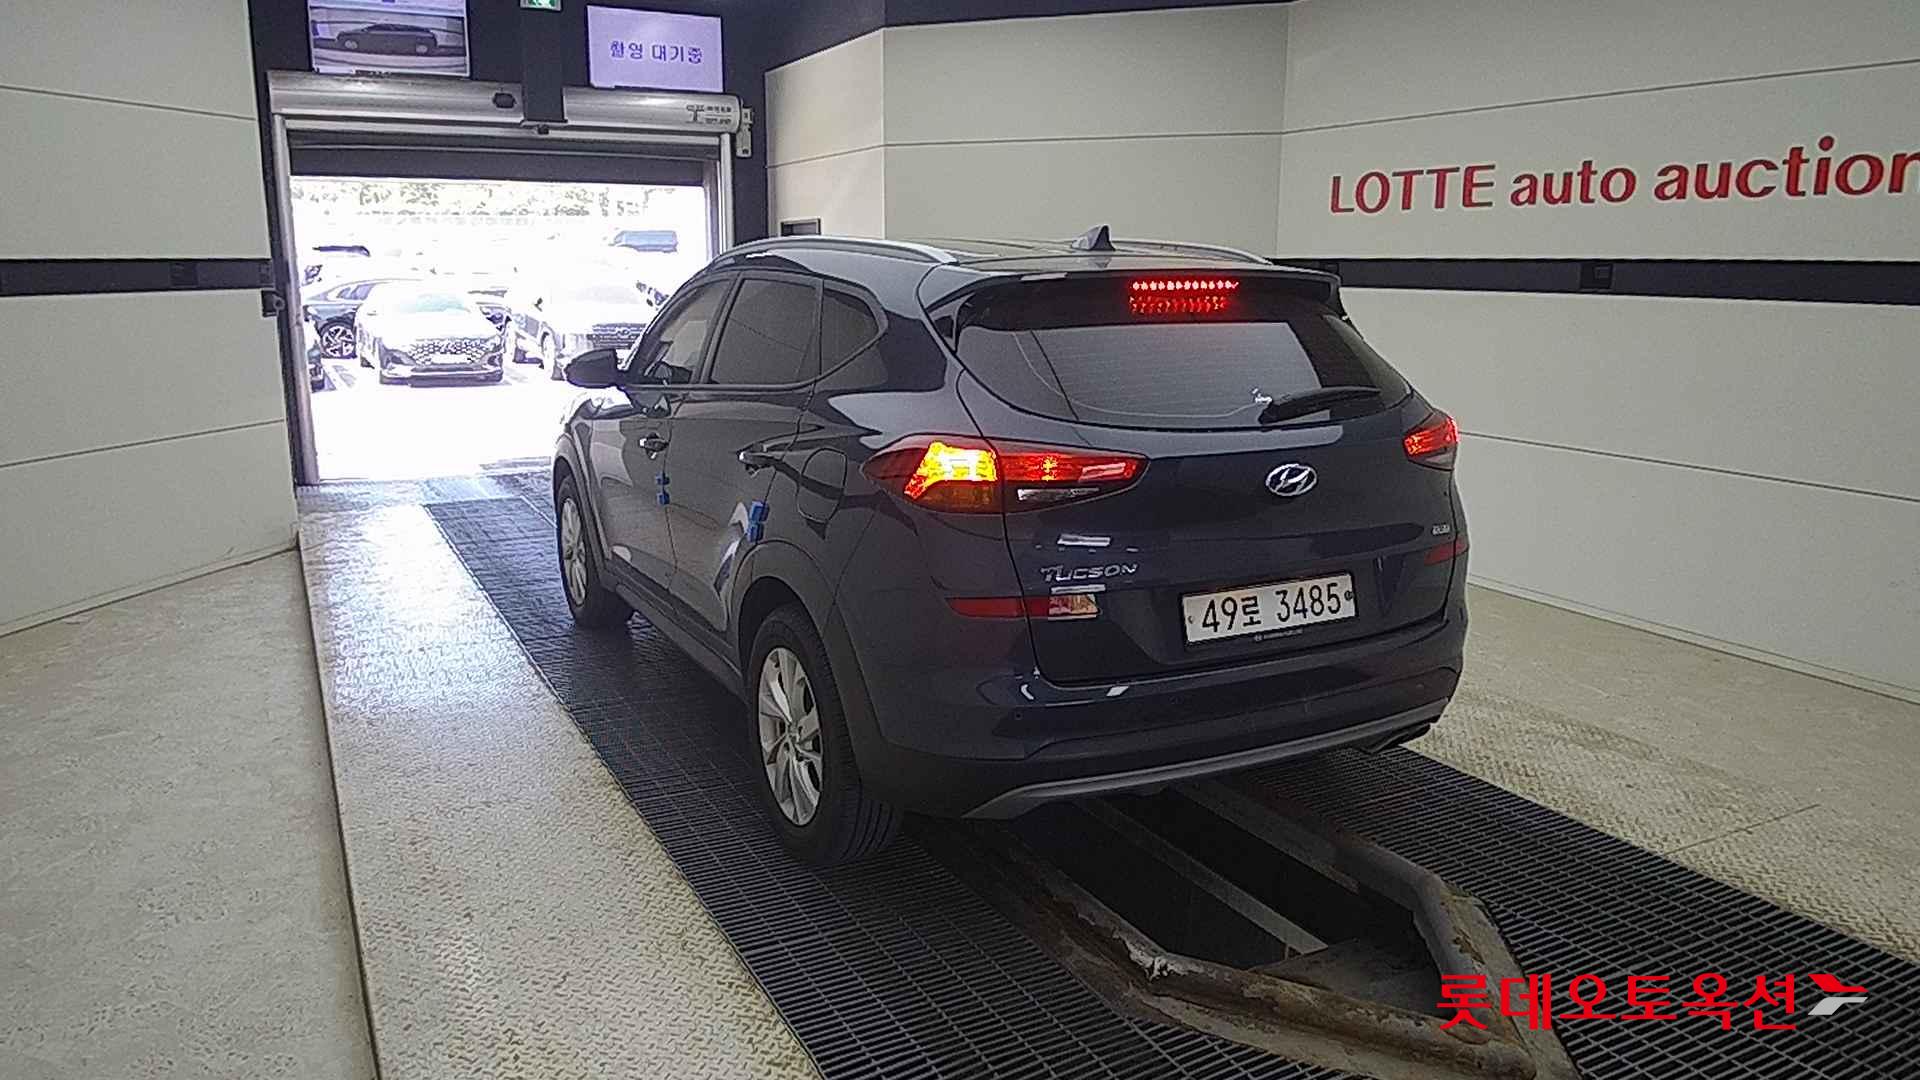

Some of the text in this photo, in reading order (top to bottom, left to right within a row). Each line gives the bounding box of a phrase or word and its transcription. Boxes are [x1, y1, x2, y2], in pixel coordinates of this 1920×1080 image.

[651, 44, 703, 64] 대기중
[1331, 164, 1495, 214] LOTTE
[1510, 160, 1637, 206] auto
[1040, 563, 1138, 582] TUCSON
[1202, 582, 1341, 633] 49로 3485
